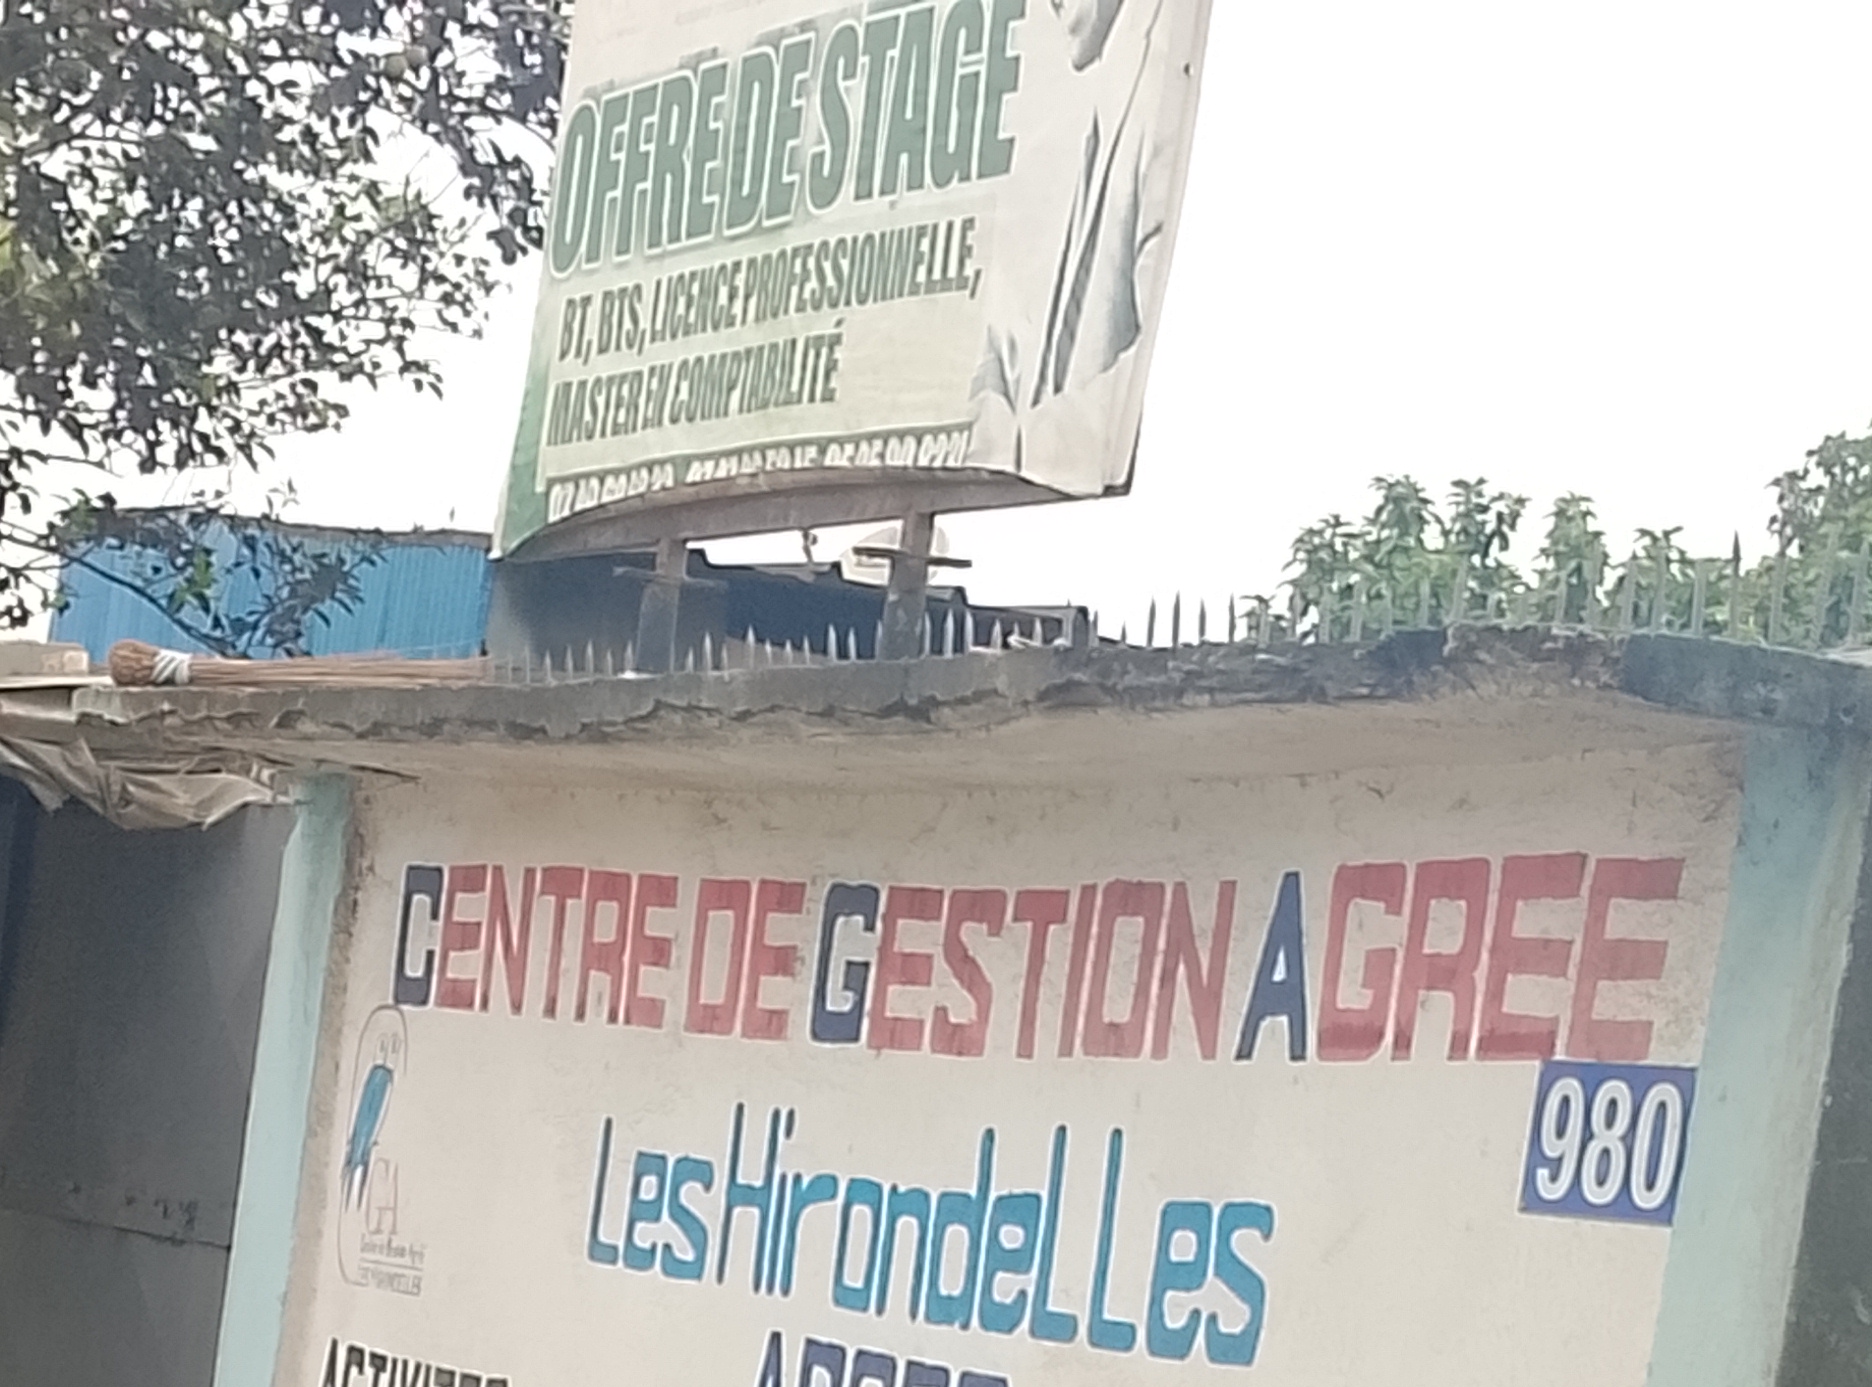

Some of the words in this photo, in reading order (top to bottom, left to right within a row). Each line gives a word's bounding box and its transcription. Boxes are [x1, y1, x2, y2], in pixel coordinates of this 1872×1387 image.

[551, 62, 728, 277] OFFRE
[723, 34, 815, 236] DE
[806, 0, 1026, 212] STAGE
[650, 259, 742, 344] LICENCE
[546, 367, 643, 446] MASTER
[642, 362, 674, 430] EN
[669, 317, 845, 422] COMPTABILITÉ
[393, 864, 678, 1029] CENTRE
[684, 878, 806, 1040] DE
[810, 875, 1237, 1060] GESTION
[1234, 853, 1685, 1061] AGREE
[587, 1116, 714, 1281] Les
[1533, 1076, 1684, 1211] 980
